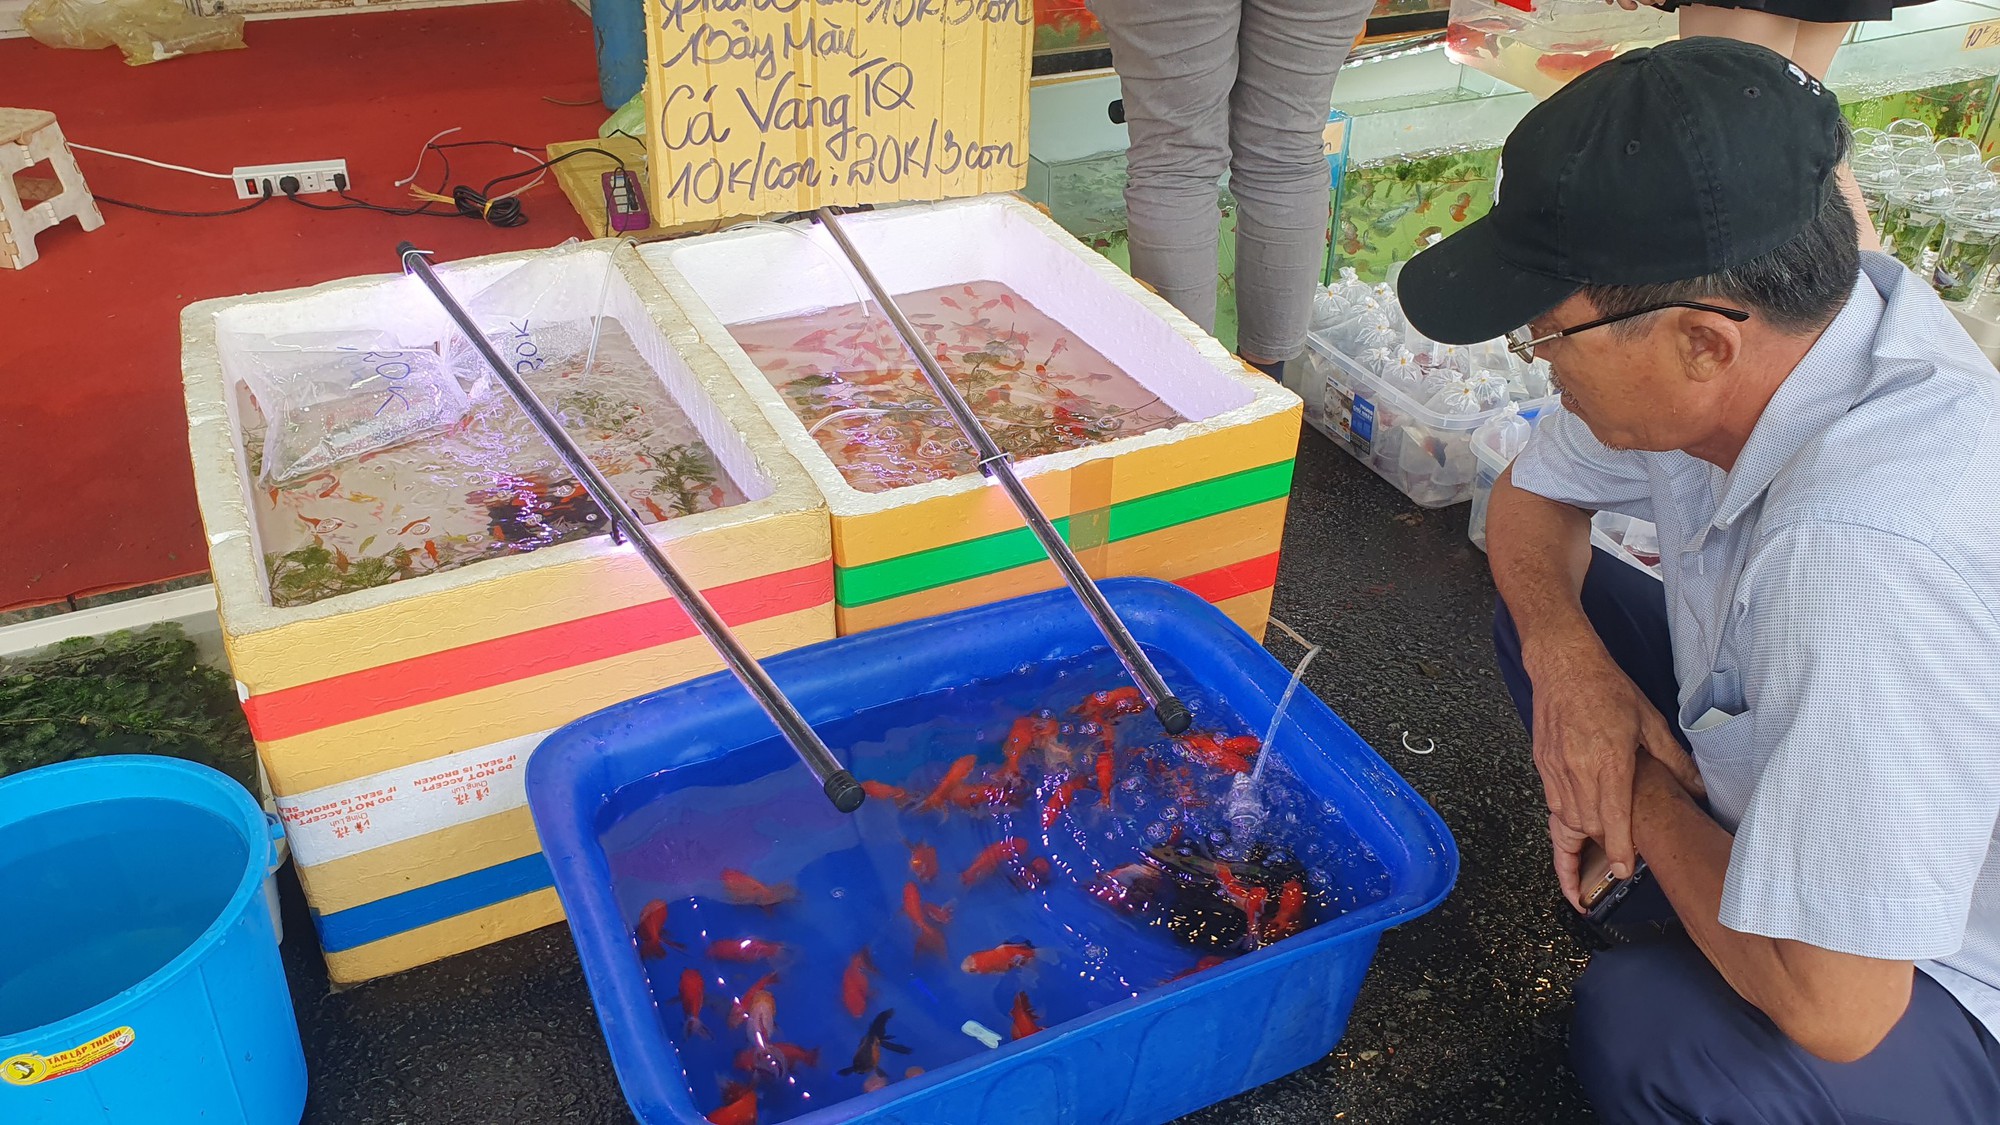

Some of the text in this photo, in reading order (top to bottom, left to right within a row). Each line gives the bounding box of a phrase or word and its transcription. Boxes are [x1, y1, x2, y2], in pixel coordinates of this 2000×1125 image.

[661, 84, 731, 150] Cá
[849, 57, 915, 117] TQ
[413, 754, 517, 787] IF SEAL IS BROKEN
[421, 763, 513, 793] DO NOT ACCEPT
[387, 786, 397, 794] IF
[466, 780, 488, 791] Ching
[354, 789, 383, 801] SEAL
[377, 795, 393, 804] DO
[341, 798, 352, 806] IS
[347, 800, 376, 813] NOT
[299, 809, 343, 826] ACCEPT
[345, 812, 368, 825] Ching
[48, 1053, 67, 1065] TÂN
